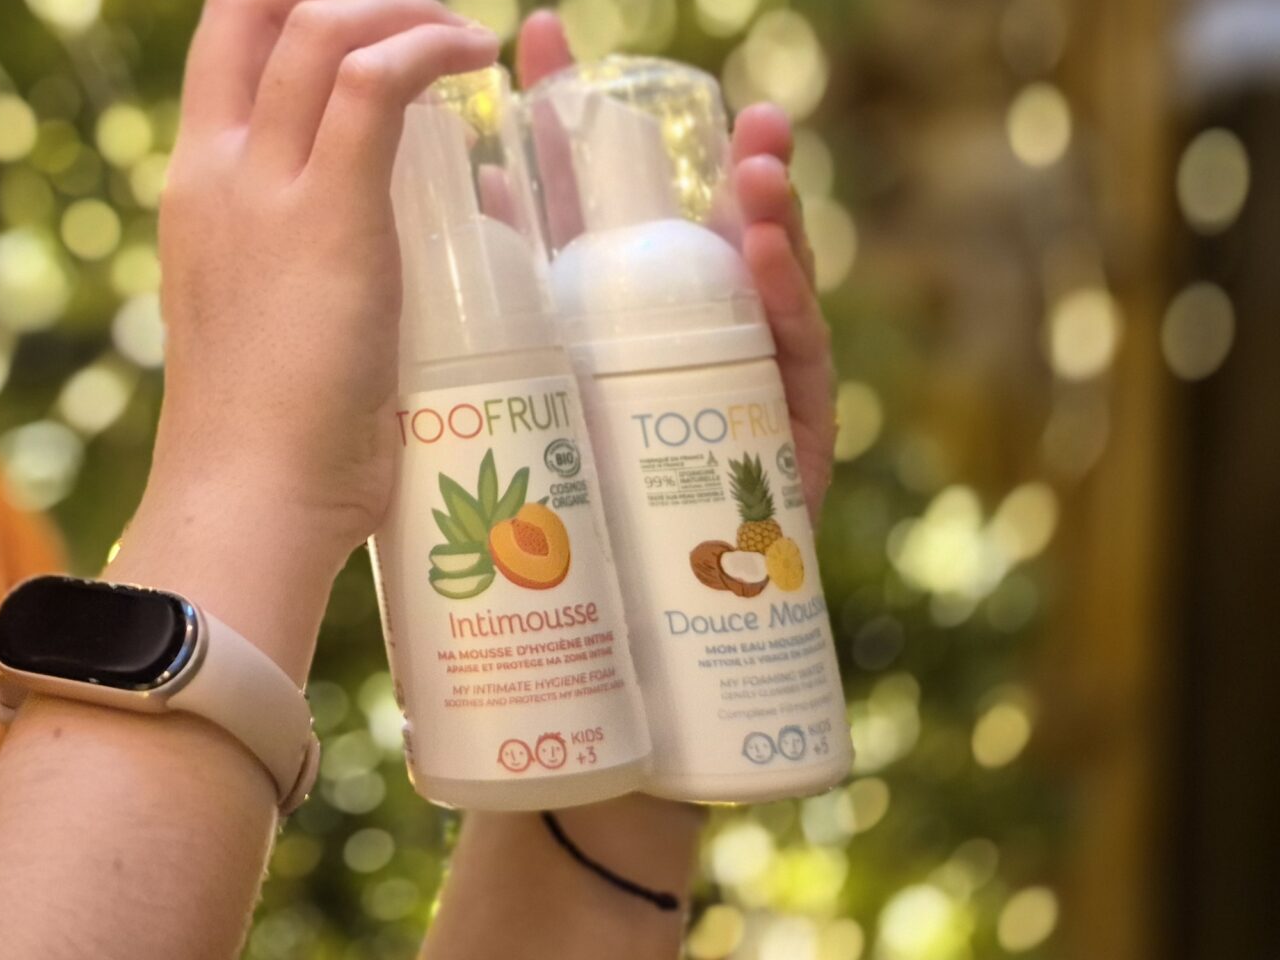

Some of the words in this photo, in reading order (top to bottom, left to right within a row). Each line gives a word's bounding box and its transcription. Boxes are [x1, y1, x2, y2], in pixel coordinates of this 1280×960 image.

[395, 391, 570, 447] TOOFRUIT
[631, 399, 790, 449] TOOFRU
[555, 451, 574, 466] BIO
[643, 475, 676, 489] 99%
[449, 601, 600, 639] Intimousse
[663, 610, 760, 636] Douce
[768, 594, 827, 628] Mous
[437, 649, 457, 662] MA
[458, 646, 513, 661] MOUSSE
[705, 643, 738, 655] MON
[741, 640, 767, 653] EAU
[446, 663, 480, 674] APAISE
[482, 662, 494, 673] ET
[546, 656, 562, 667] MA
[564, 651, 589, 664] ZONE
[452, 684, 471, 696] MY
[472, 679, 532, 695] INTIMATE
[535, 671, 587, 690] HYGIENE
[486, 695, 508, 707] AND
[570, 727, 604, 745] KIDS
[576, 746, 598, 766] +3
